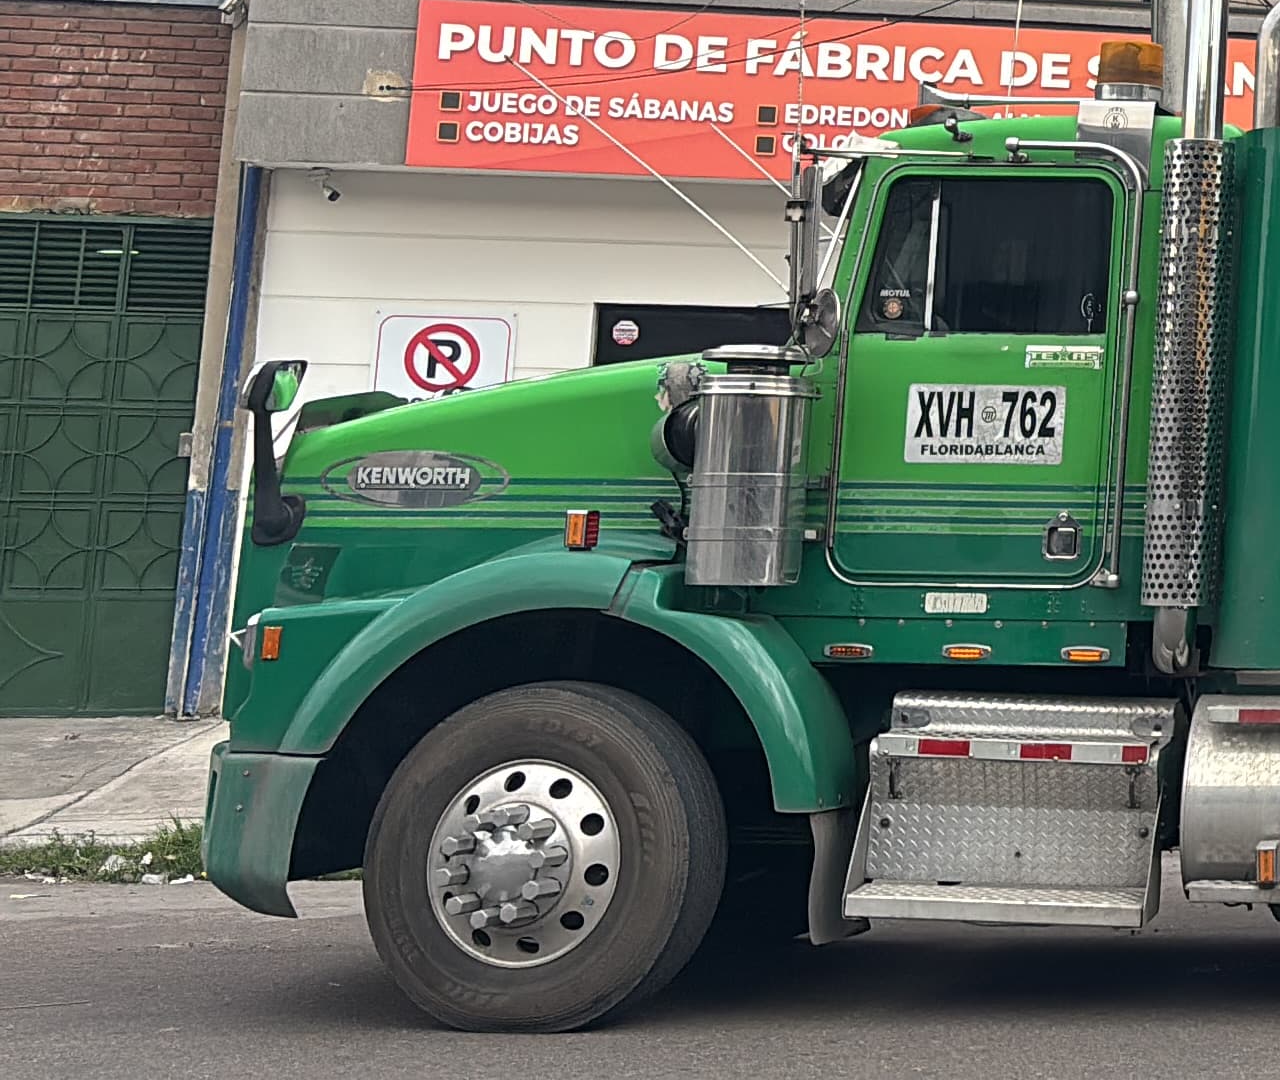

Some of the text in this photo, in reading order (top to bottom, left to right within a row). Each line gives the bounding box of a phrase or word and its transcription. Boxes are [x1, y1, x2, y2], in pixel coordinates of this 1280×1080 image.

[437, 23, 637, 69] PUNTO
[653, 34, 728, 73] DE
[745, 31, 983, 85] FÁBRICA
[1000, 52, 1071, 89] DE
[467, 92, 735, 123] JUEGO DE SÁBANAS
[465, 120, 579, 145] COBIJAS
[880, 289, 911, 297] MOTUL
[914, 391, 1057, 438] XVH 762
[921, 444, 1045, 456] FLORIDABLANCA
[357, 467, 470, 485] KENWORTH
